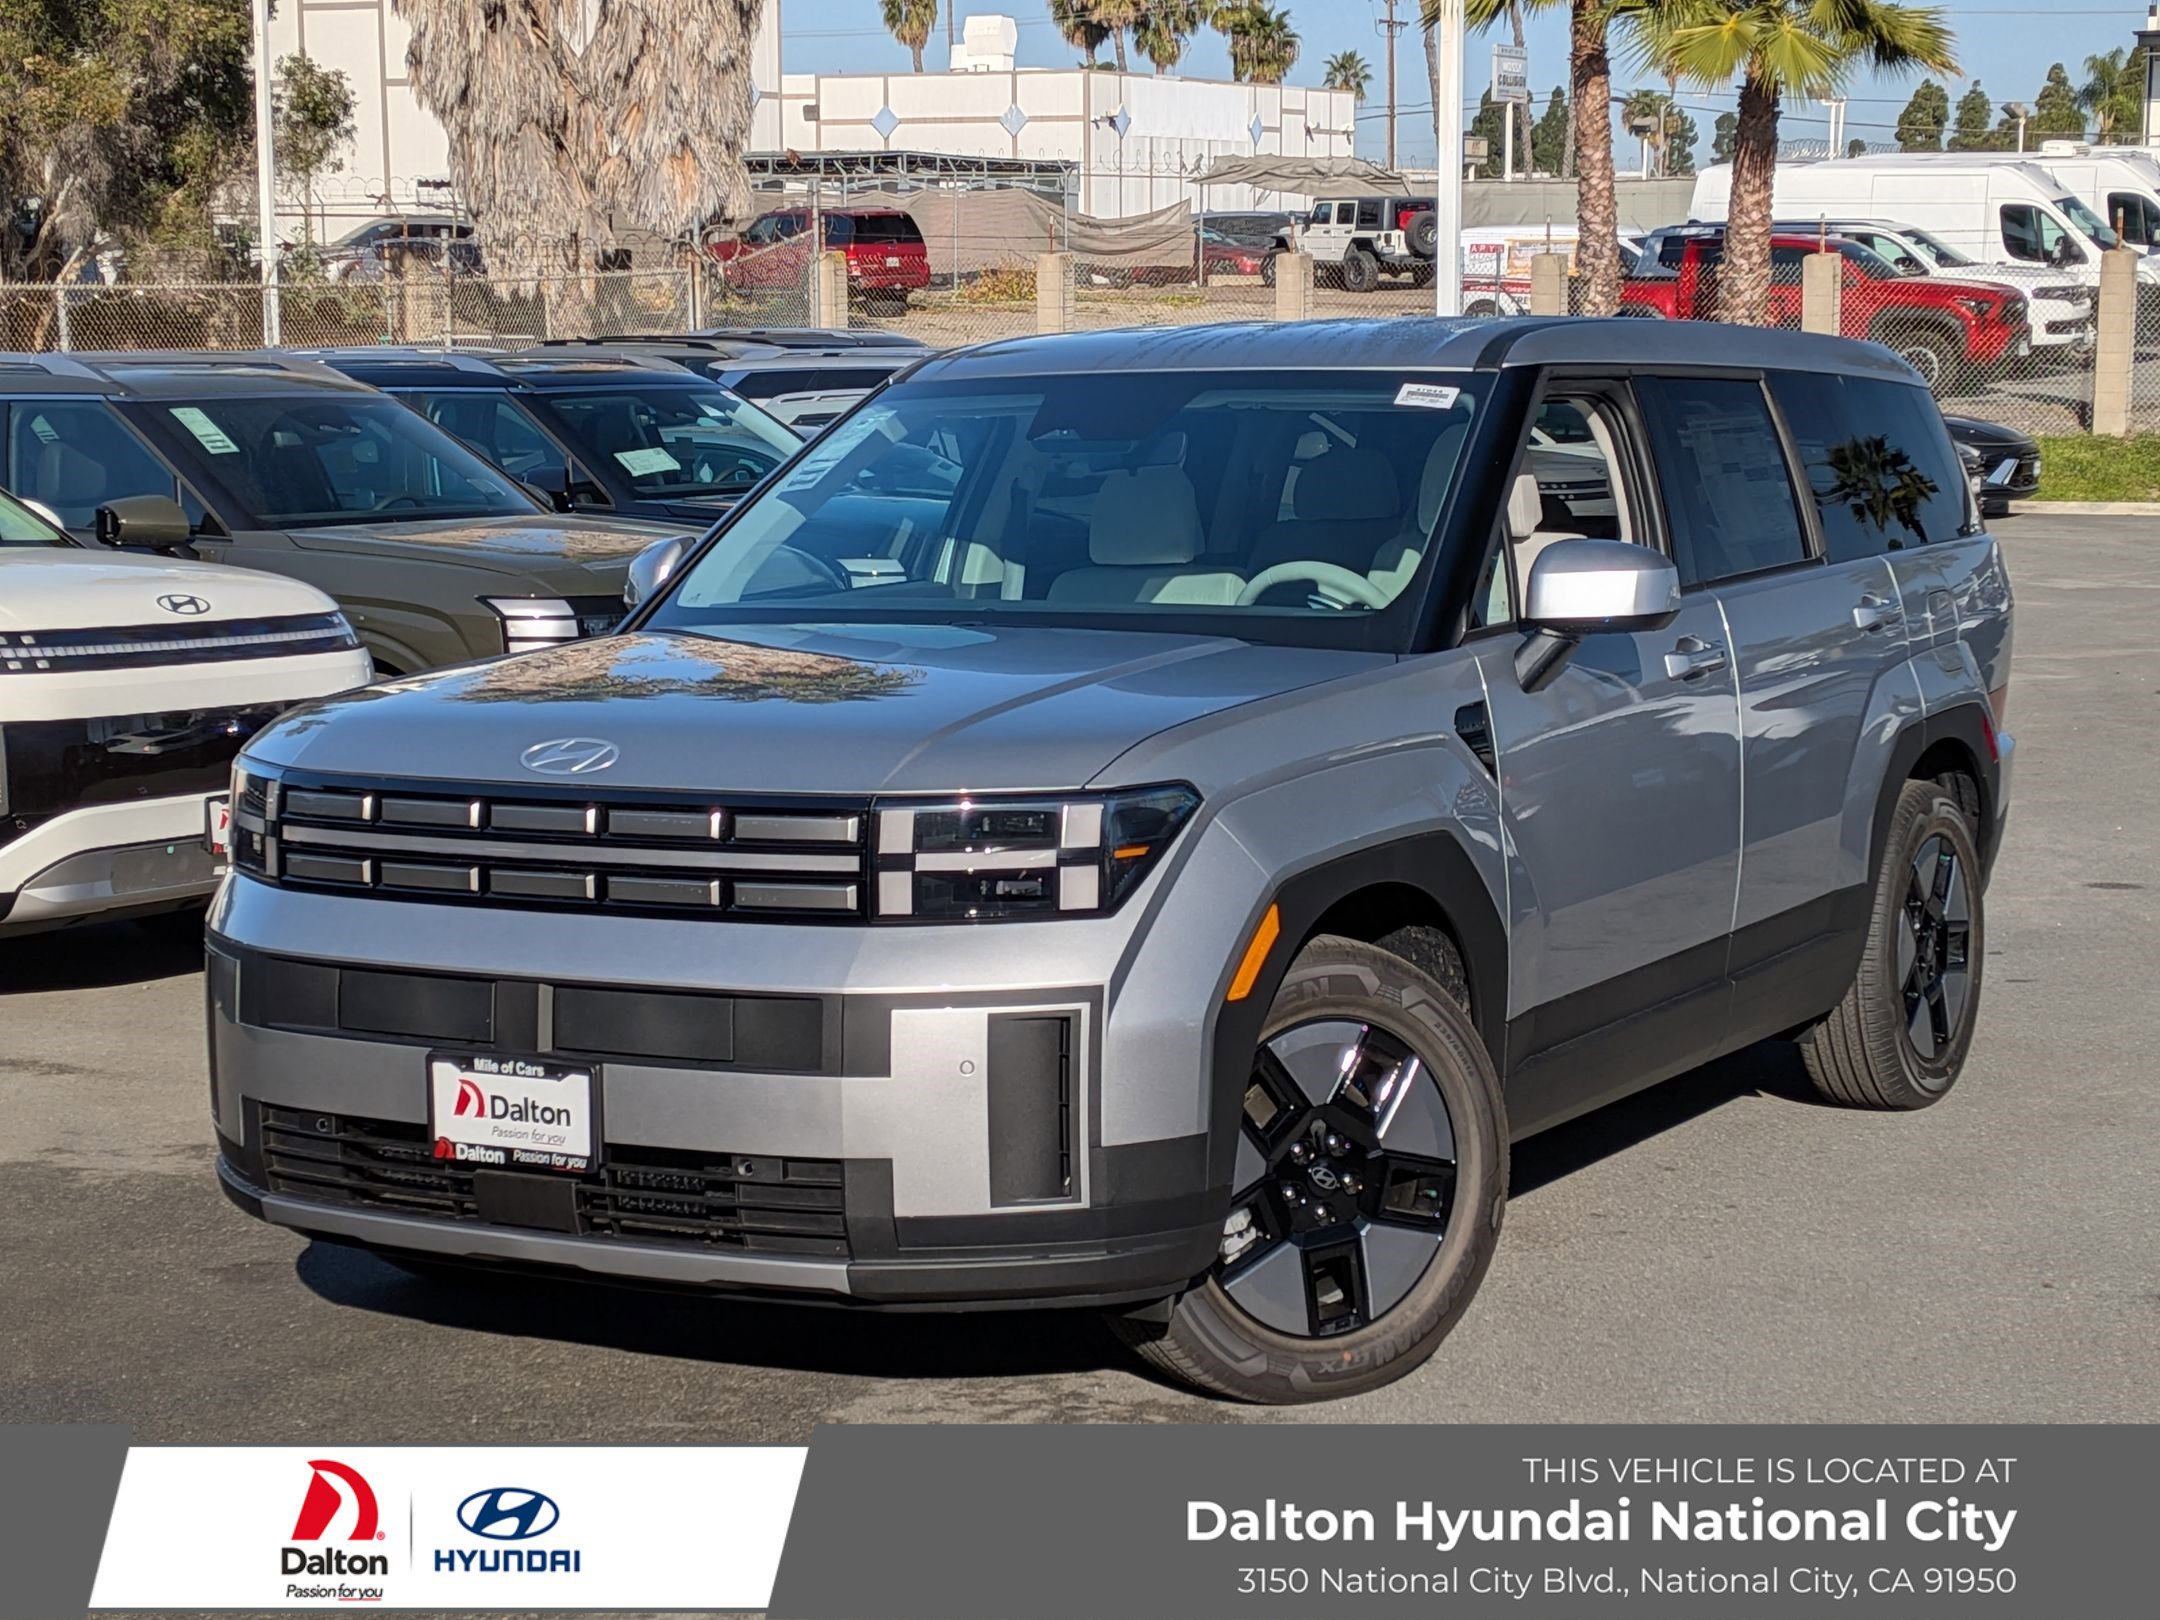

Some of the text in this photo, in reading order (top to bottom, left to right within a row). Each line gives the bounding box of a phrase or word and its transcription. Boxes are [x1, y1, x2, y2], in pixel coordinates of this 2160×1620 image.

[473, 1058, 545, 1077] Mile of Cars
[490, 1095, 571, 1127] Dalton
[491, 1126, 566, 1145] Passion for you
[456, 1143, 506, 1164] Dalton
[512, 1149, 587, 1170] Passion for you
